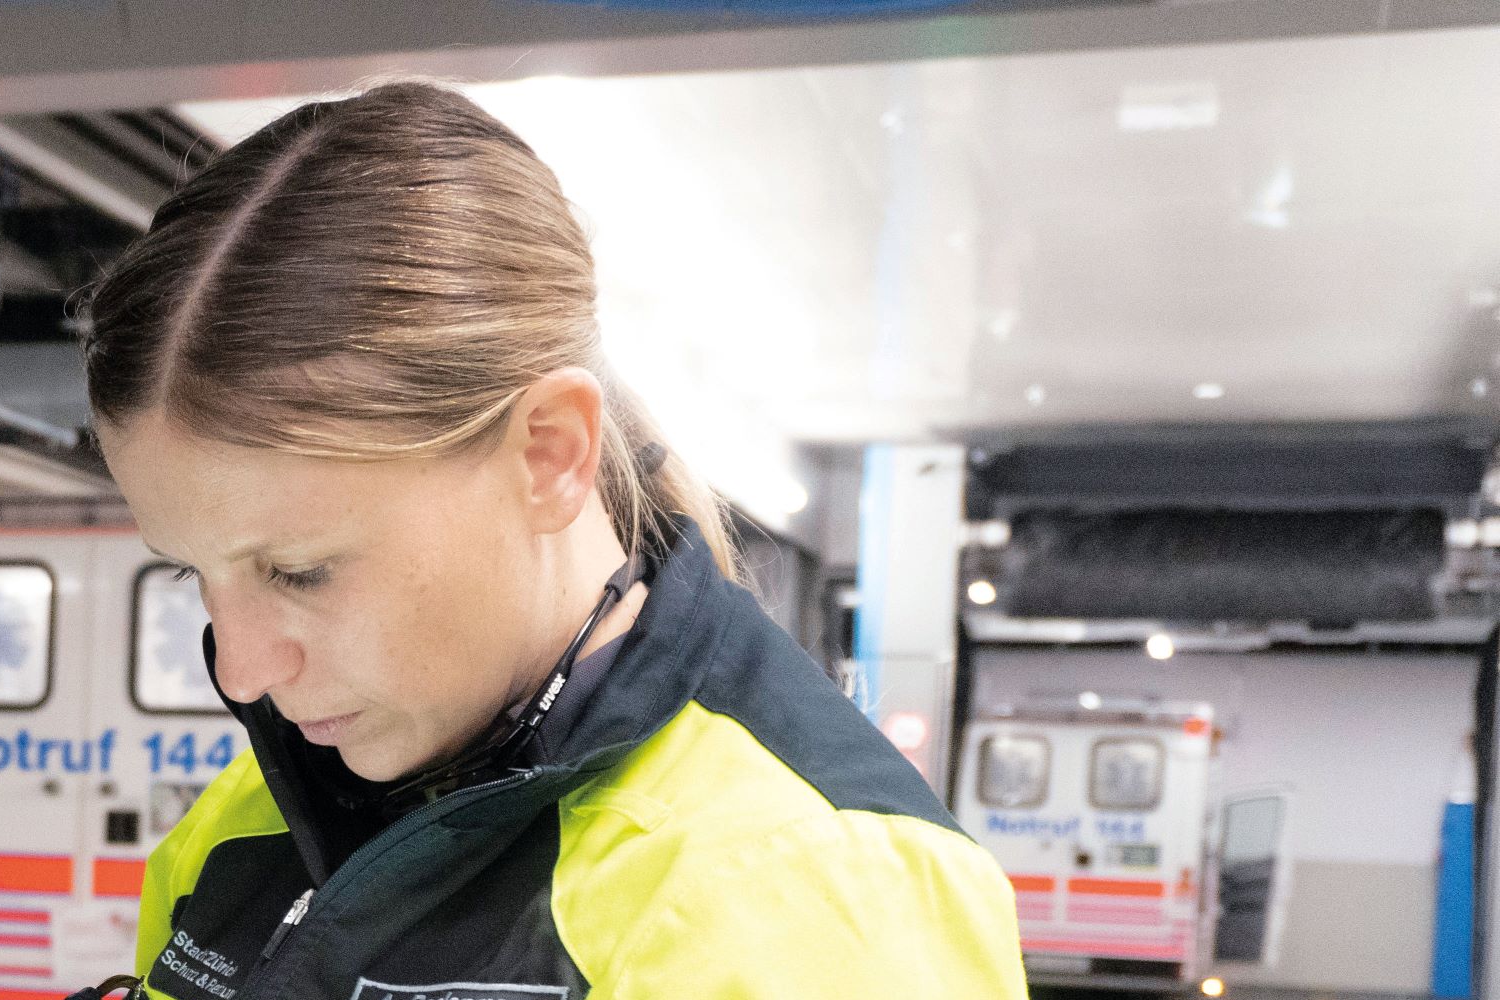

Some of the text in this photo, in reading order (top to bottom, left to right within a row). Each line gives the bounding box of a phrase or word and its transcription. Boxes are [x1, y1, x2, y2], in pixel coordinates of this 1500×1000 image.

[538, 672, 566, 711] uvex
[142, 731, 235, 774] 144
[196, 973, 209, 989] &
